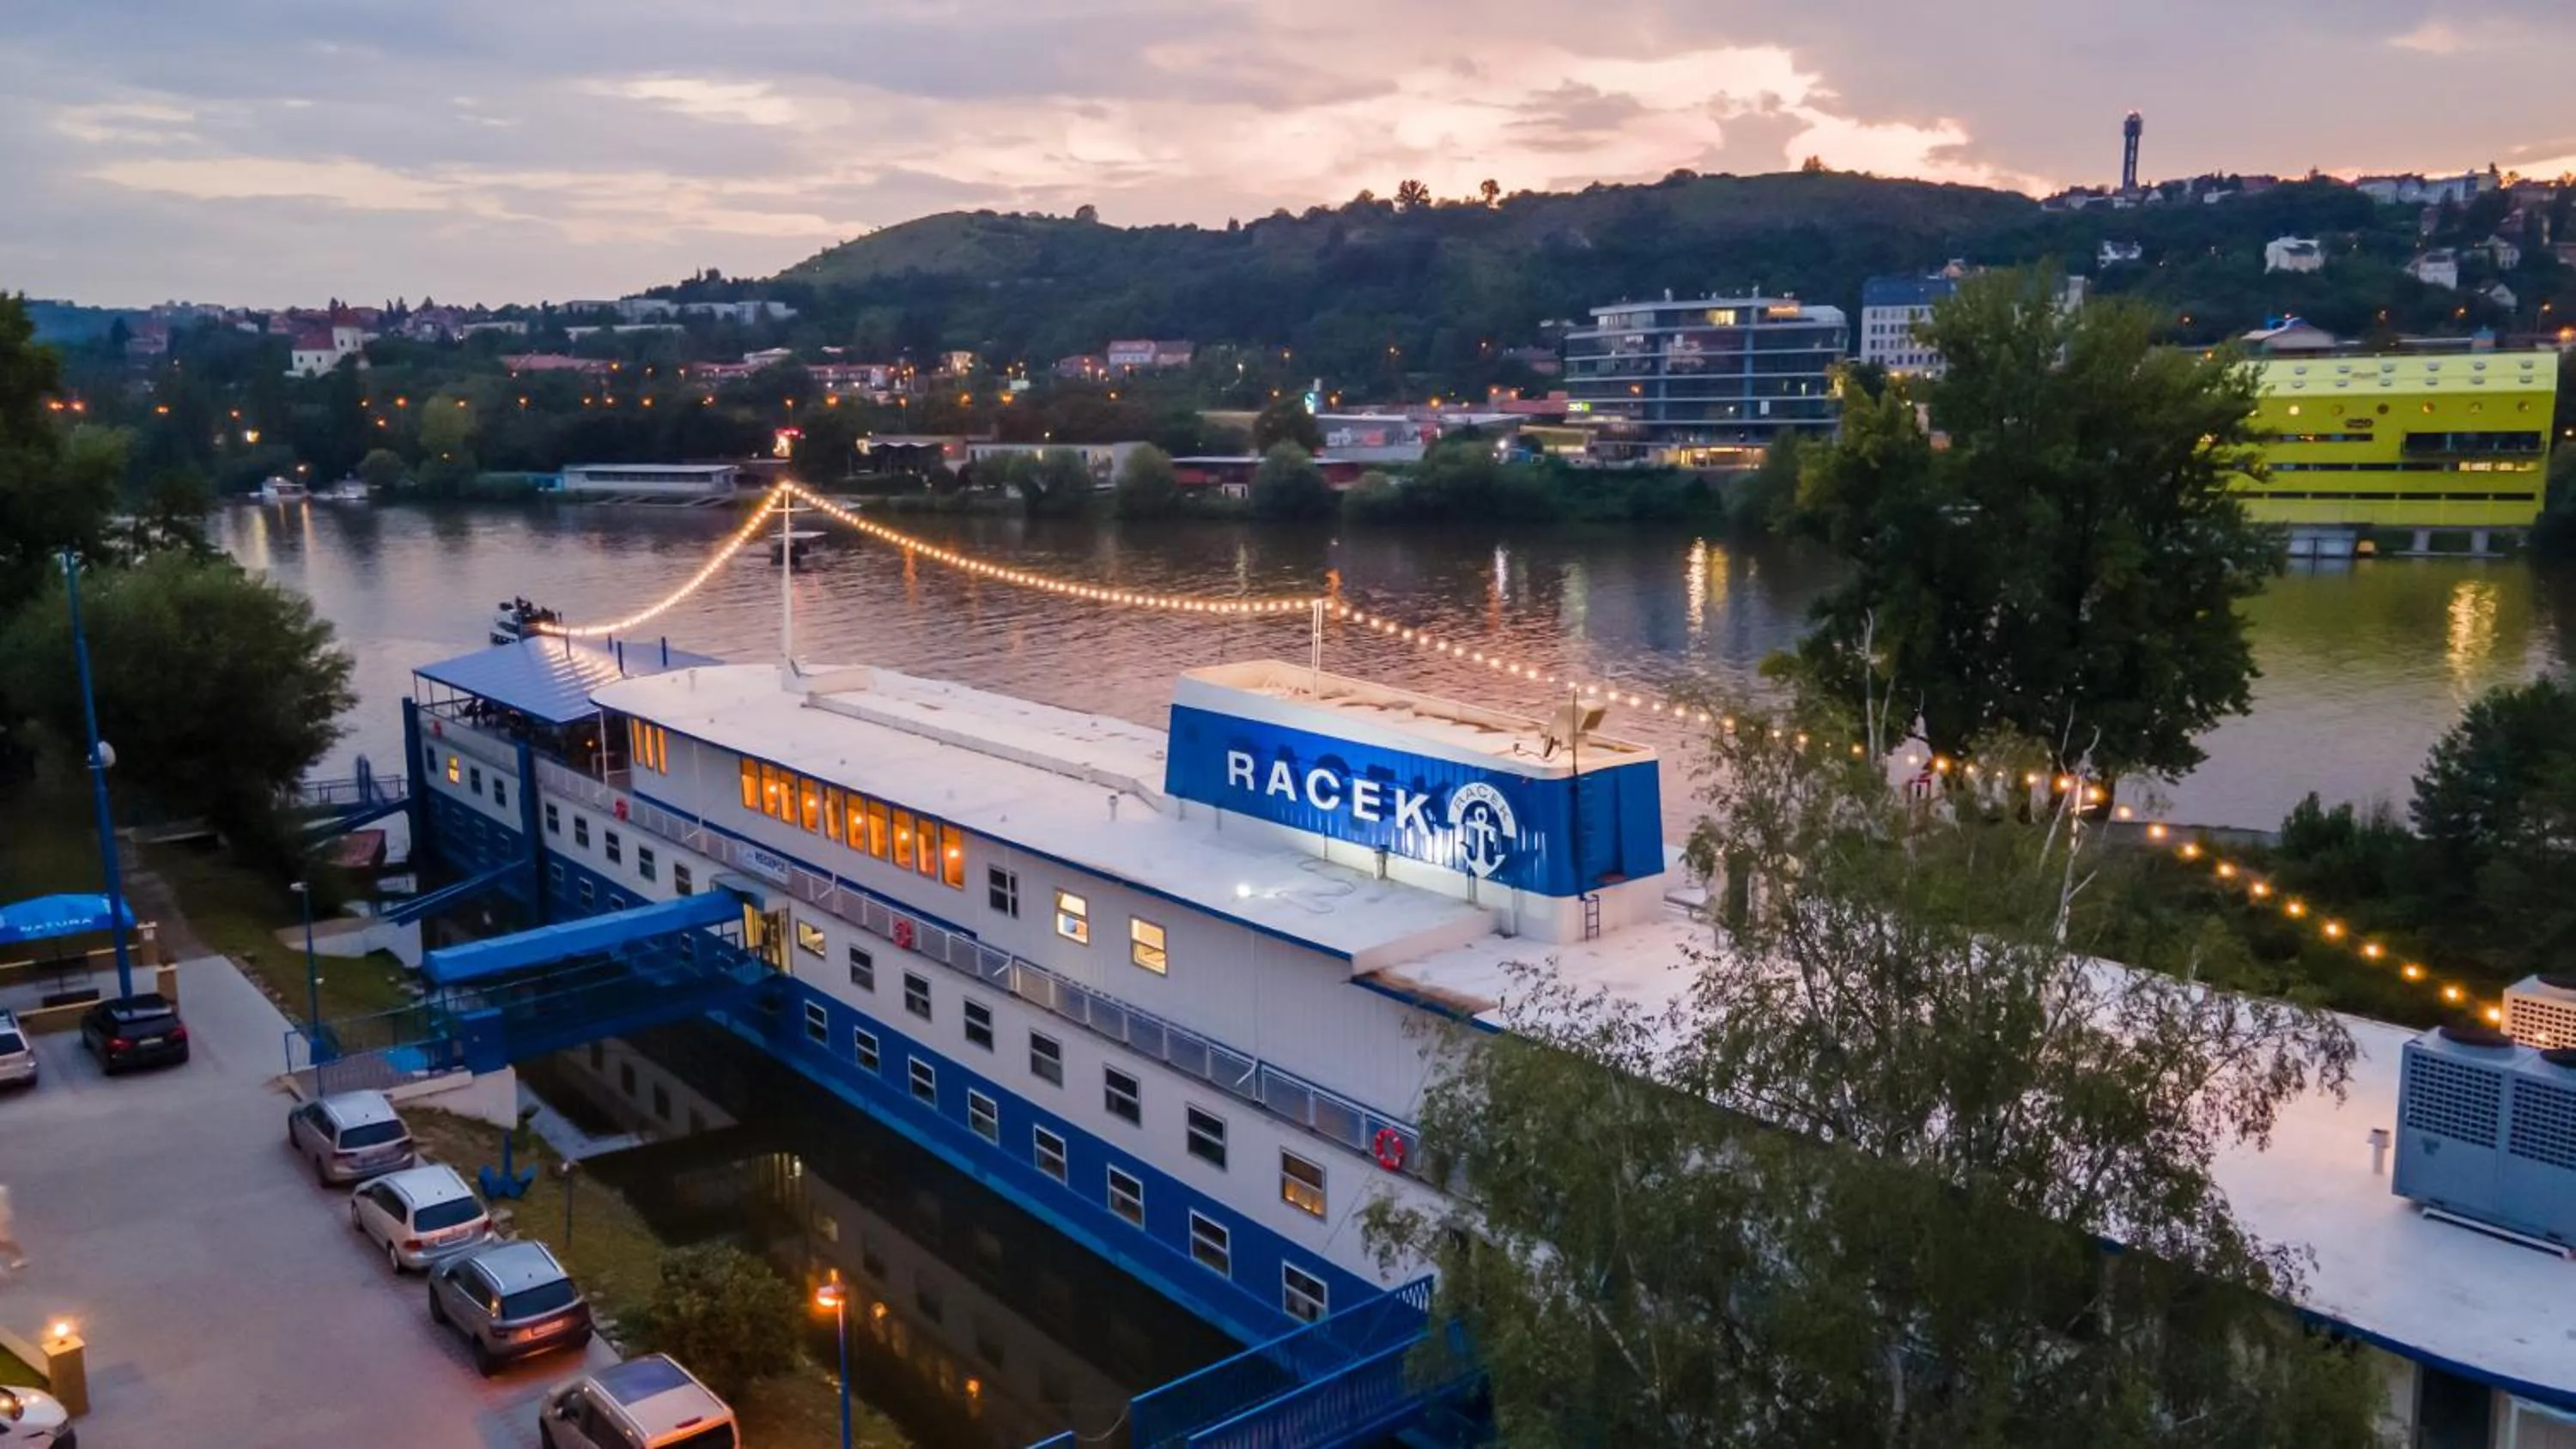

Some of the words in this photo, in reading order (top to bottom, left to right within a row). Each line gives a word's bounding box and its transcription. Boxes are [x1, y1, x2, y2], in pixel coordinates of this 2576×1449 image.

[1228, 750, 1435, 835] RACEK
[1453, 784, 1510, 822] RACEK
[19, 918, 93, 932] NATURA
